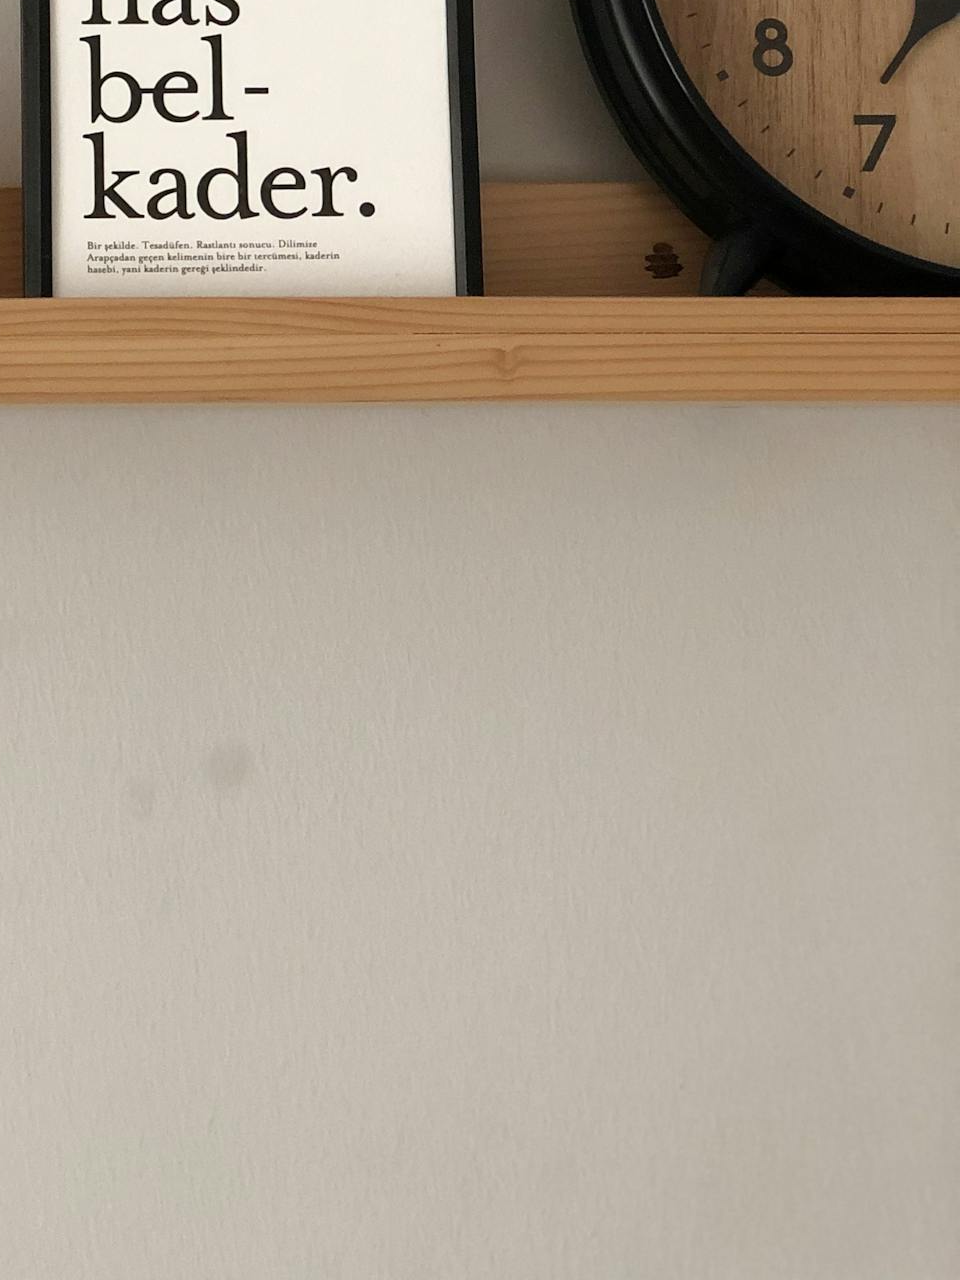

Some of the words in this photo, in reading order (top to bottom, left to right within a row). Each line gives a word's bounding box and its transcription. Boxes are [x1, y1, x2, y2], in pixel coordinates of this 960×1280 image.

[753, 18, 794, 77] 8
[79, 34, 270, 124] bel-
[854, 115, 897, 173] 7
[83, 130, 376, 221] kader.
[87, 240, 103, 250] Bir
[104, 240, 139, 252] şekilde.
[141, 240, 193, 250] Tesadüfen.
[196, 239, 237, 249] Rastlantı
[239, 241, 275, 249] sonucu.
[278, 239, 318, 249] Dilimize
[87, 253, 136, 264] Arapçadan
[138, 255, 165, 264] geçen
[167, 252, 214, 261] kelimenin
[216, 252, 236, 261] bire
[237, 252, 252, 260] bir
[254, 252, 302, 261] tercümesi,
[305, 250, 340, 260] kaderin
[87, 264, 120, 274] hasebi,
[121, 266, 141, 276] yani
[144, 264, 179, 273] kaderin
[181, 265, 209, 276] gereği
[211, 263, 267, 275] şeklindedir.
